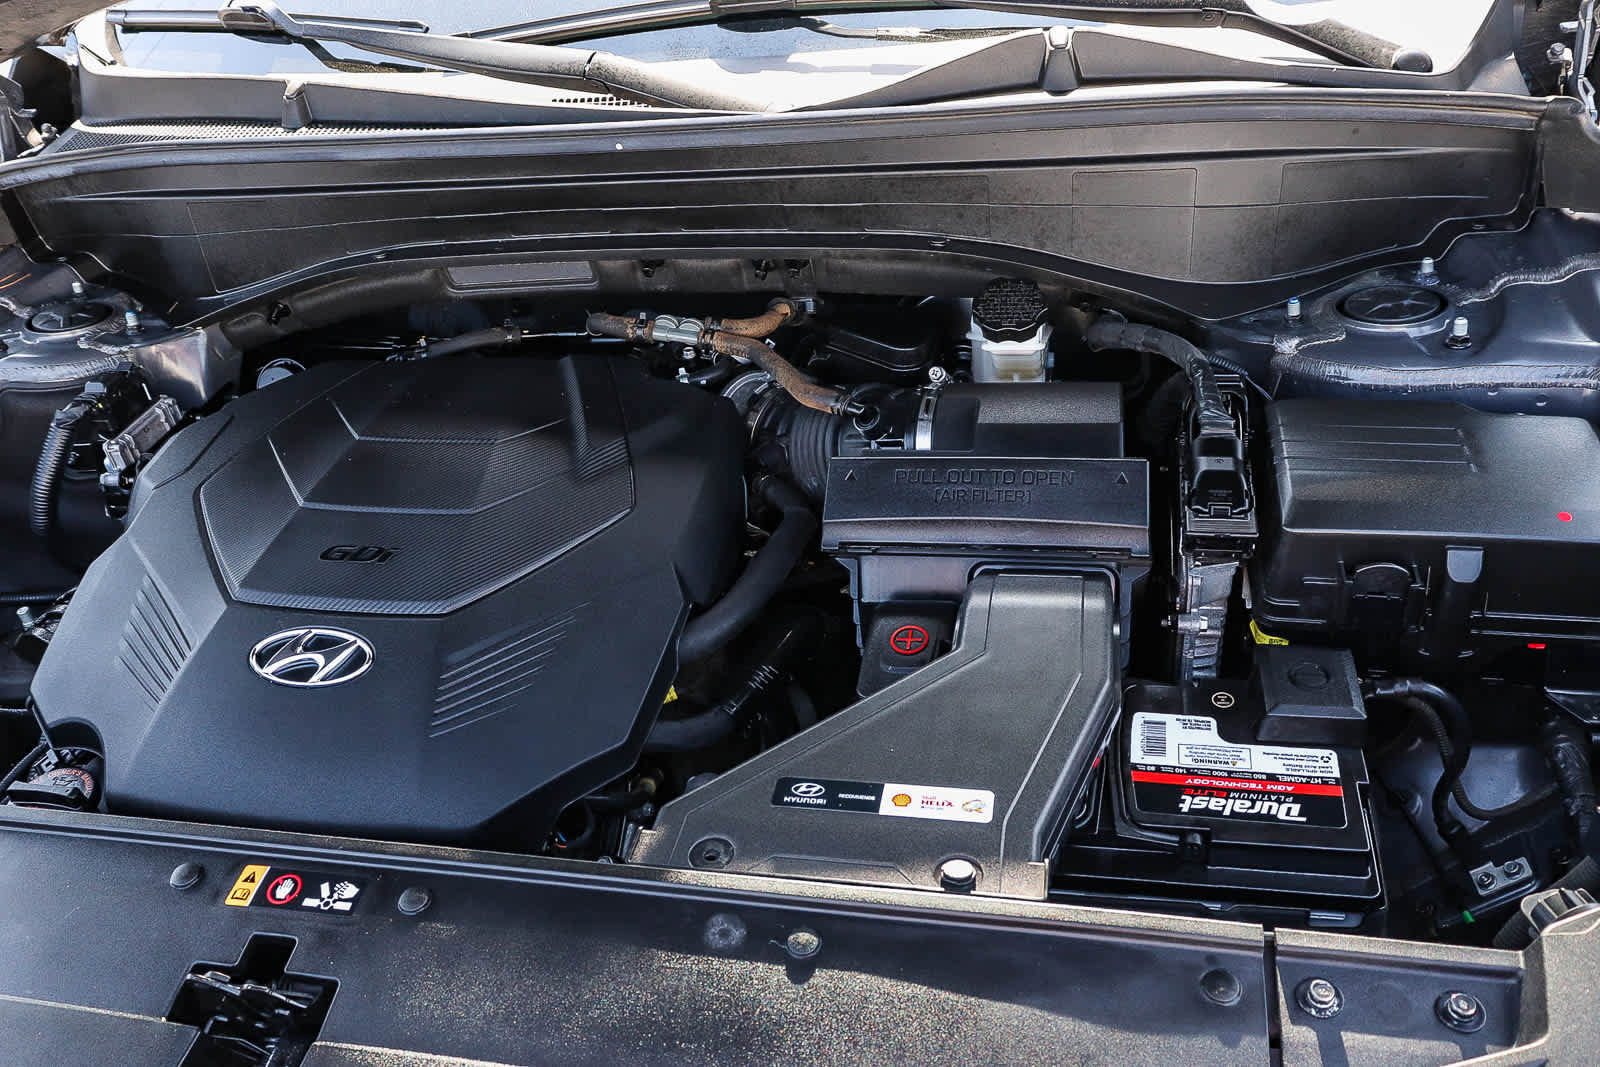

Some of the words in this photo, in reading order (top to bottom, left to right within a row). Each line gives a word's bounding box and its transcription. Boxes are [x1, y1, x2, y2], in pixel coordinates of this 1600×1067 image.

[894, 467, 942, 485] PULL
[946, 468, 986, 486] OUT
[992, 468, 1017, 486] TO
[1021, 469, 1075, 487] OPEN
[1184, 777, 1263, 789] TECHNOLOGY
[1276, 774, 1322, 784] H7-AGMEL
[1185, 788, 1227, 797] ELITE
[1266, 783, 1295, 792] AGM
[1229, 791, 1293, 802] PLATINUM
[1177, 794, 1308, 822] Duralast
